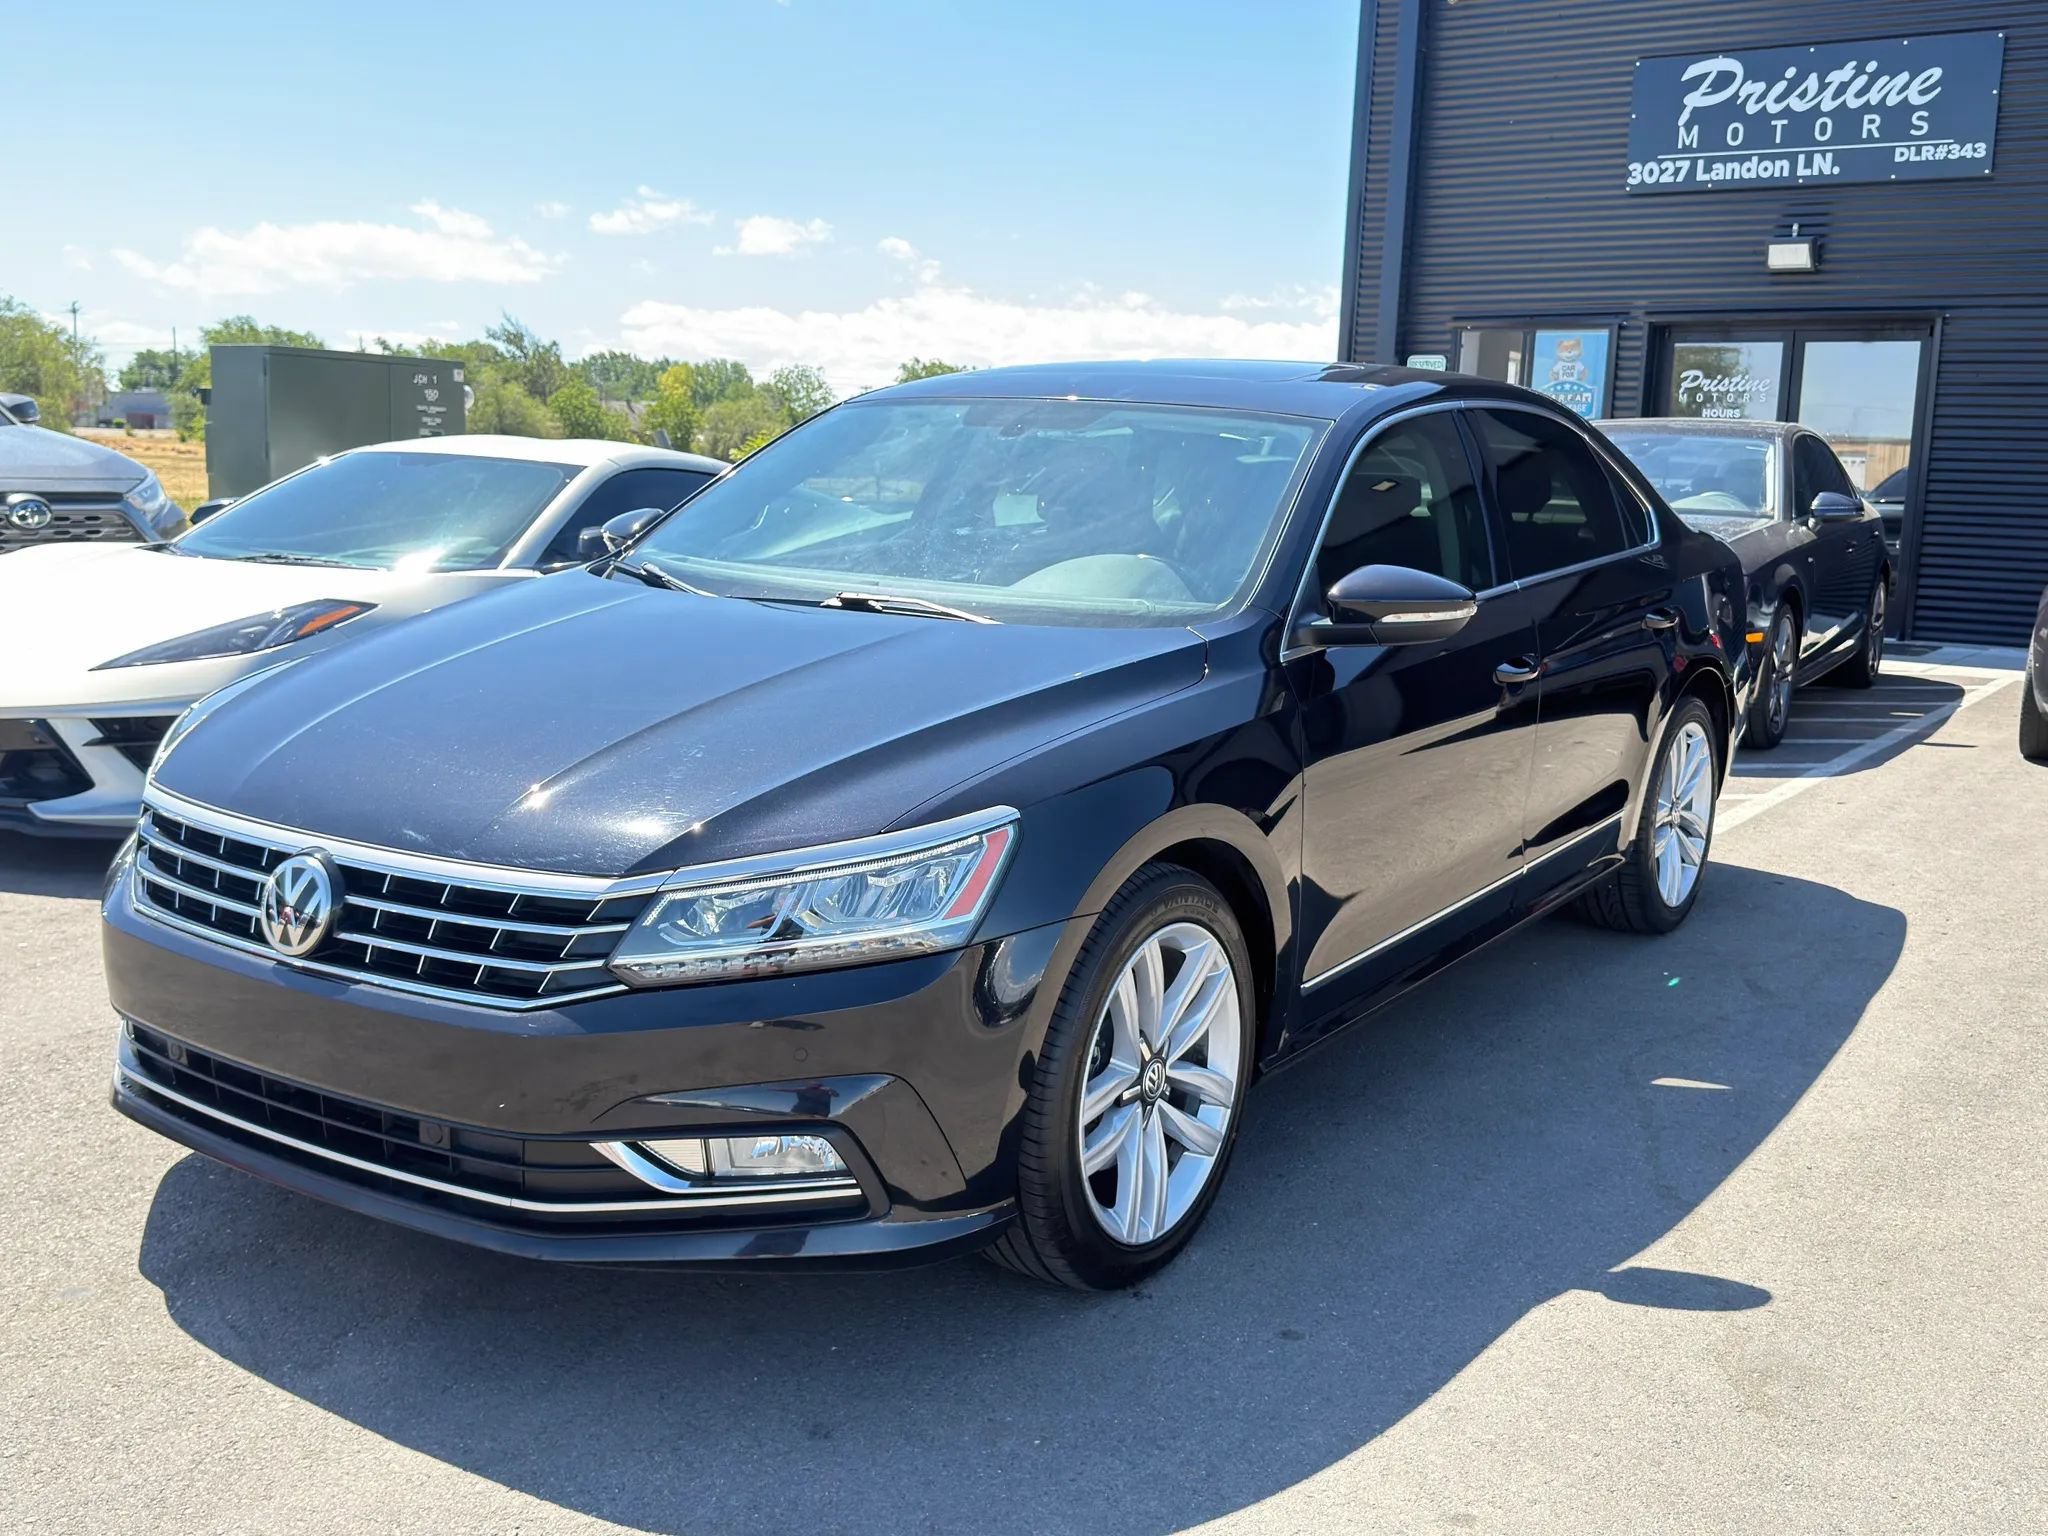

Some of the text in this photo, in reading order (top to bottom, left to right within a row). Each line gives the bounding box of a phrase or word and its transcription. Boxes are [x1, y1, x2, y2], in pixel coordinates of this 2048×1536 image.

[1677, 57, 1943, 127] Pristine
[1677, 110, 1930, 149] MOTORS
[1894, 142, 1986, 163] DLR#343
[1627, 153, 1841, 186] 3027 Landon LN.
[1679, 369, 1770, 396] Pristine
[1679, 393, 1766, 403] MOTORS
[1701, 408, 1741, 418] HOURS
